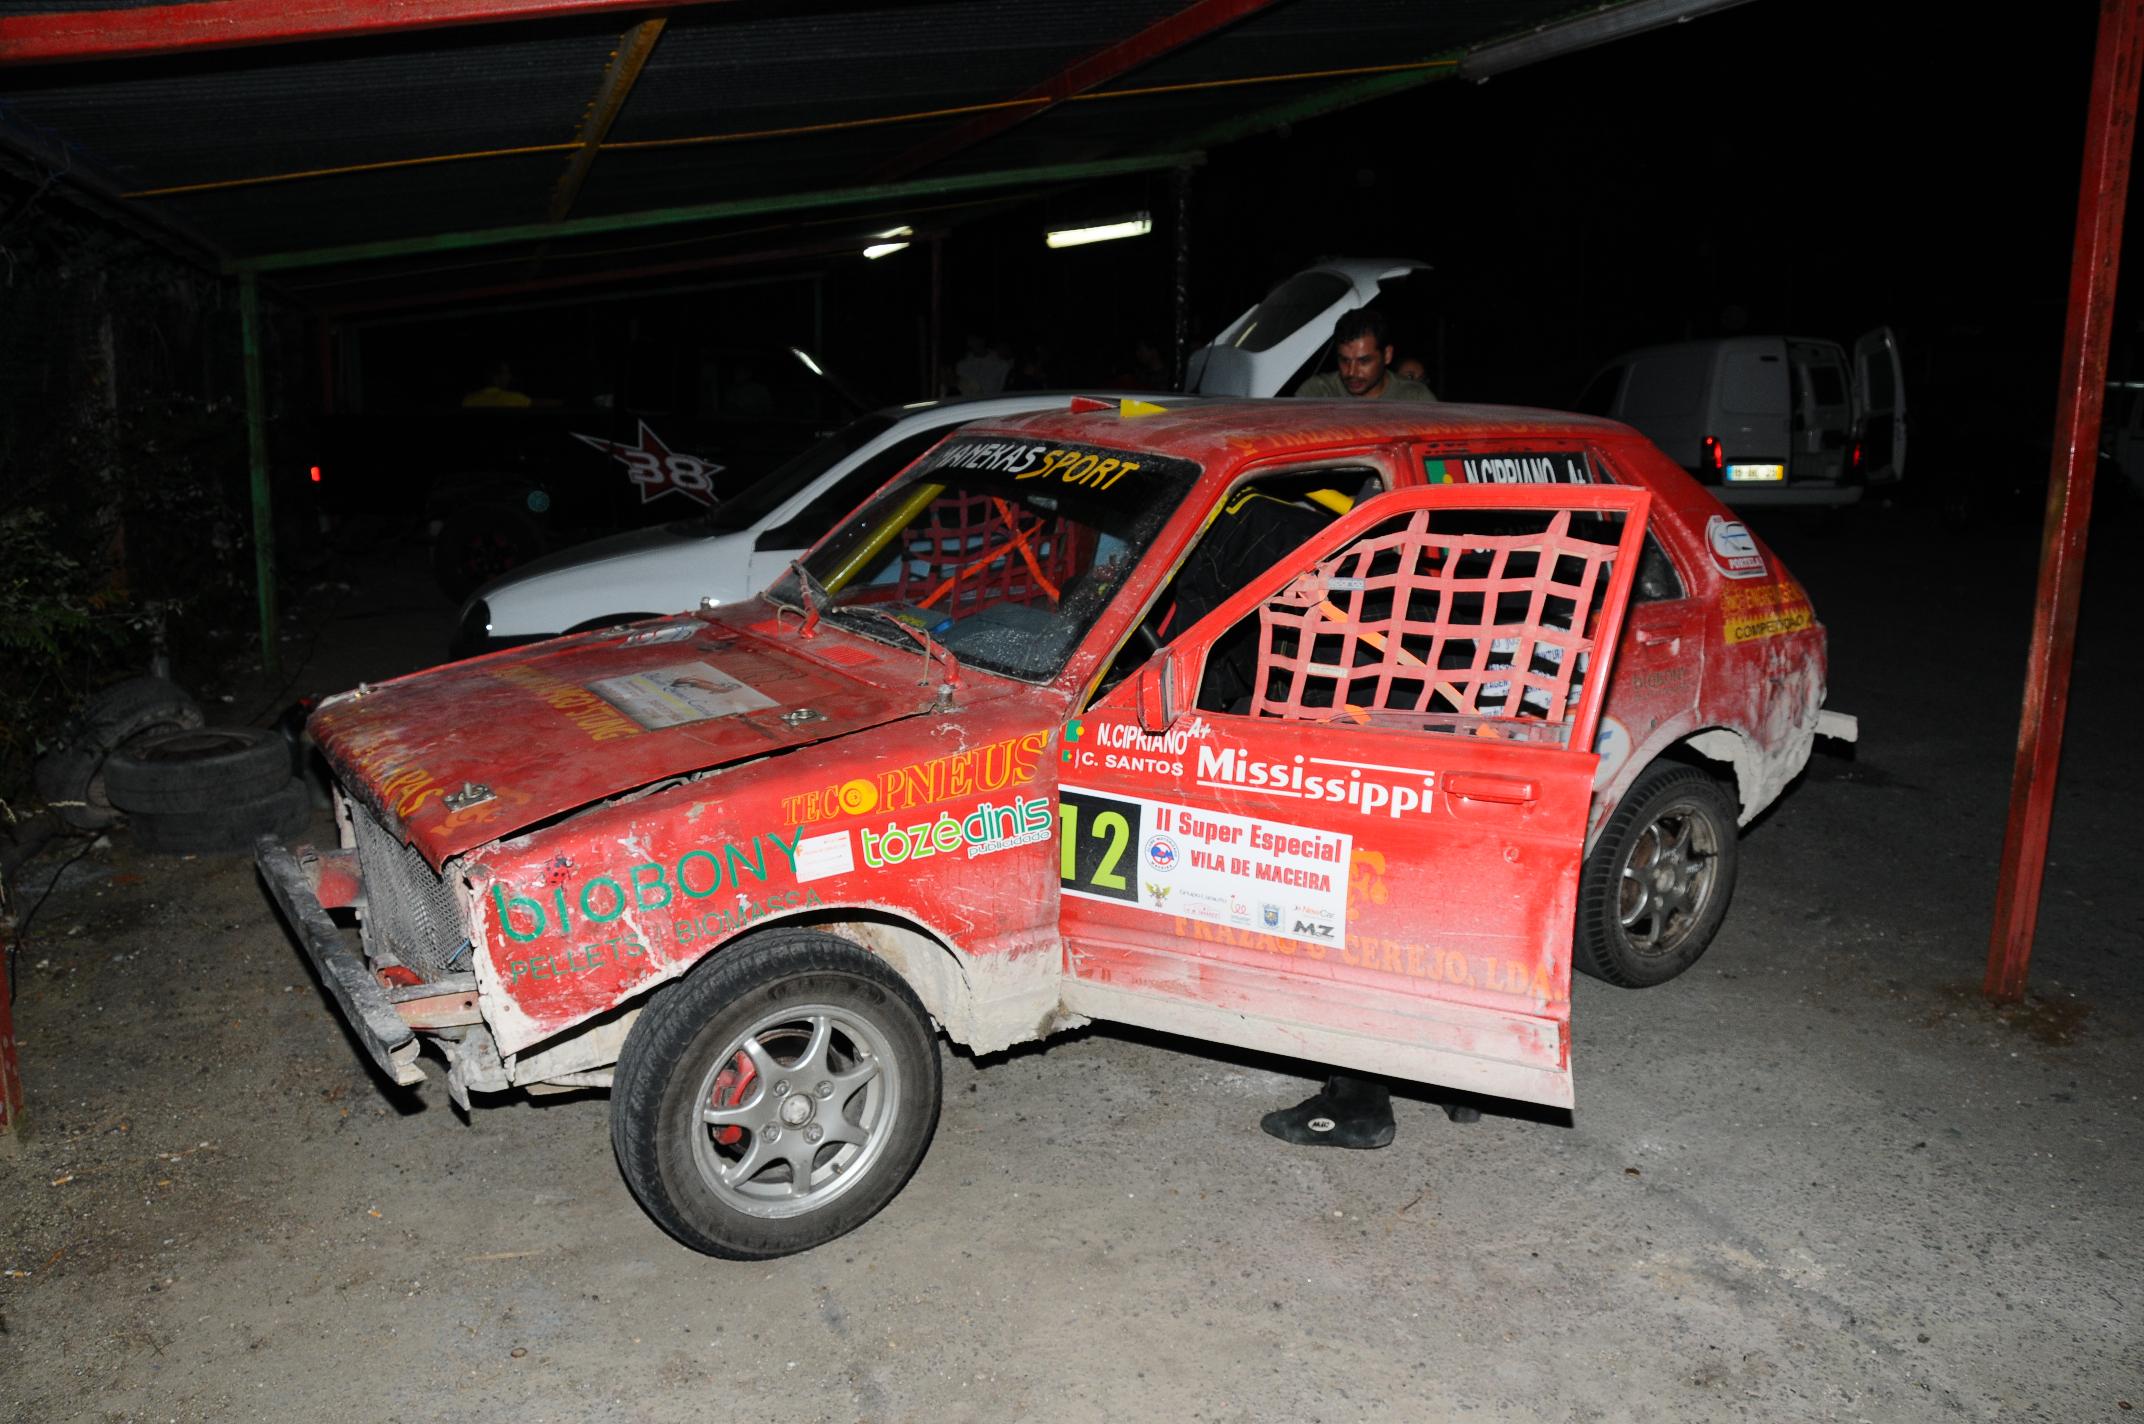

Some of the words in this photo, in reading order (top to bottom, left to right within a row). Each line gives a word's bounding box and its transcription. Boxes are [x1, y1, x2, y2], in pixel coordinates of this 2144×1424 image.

[619, 448, 714, 491] 38
[1015, 449, 1141, 490] SPORT
[1097, 722, 1188, 756] N.CIPRIANO
[1081, 751, 1099, 767] C.
[1104, 754, 1185, 777] SANTOS
[1197, 745, 1435, 818] Mississippi
[968, 830, 1051, 859] publicidade
[1059, 803, 1131, 891] 12
[1155, 807, 1172, 832] II
[1178, 812, 1244, 846] Super
[1249, 823, 1343, 865] Especial
[1190, 849, 1226, 873] VILA
[1231, 857, 1251, 877] DE
[1255, 862, 1332, 893] MACEIRA
[510, 932, 646, 985] PELLETS
[675, 886, 825, 945] BIOMASSA
